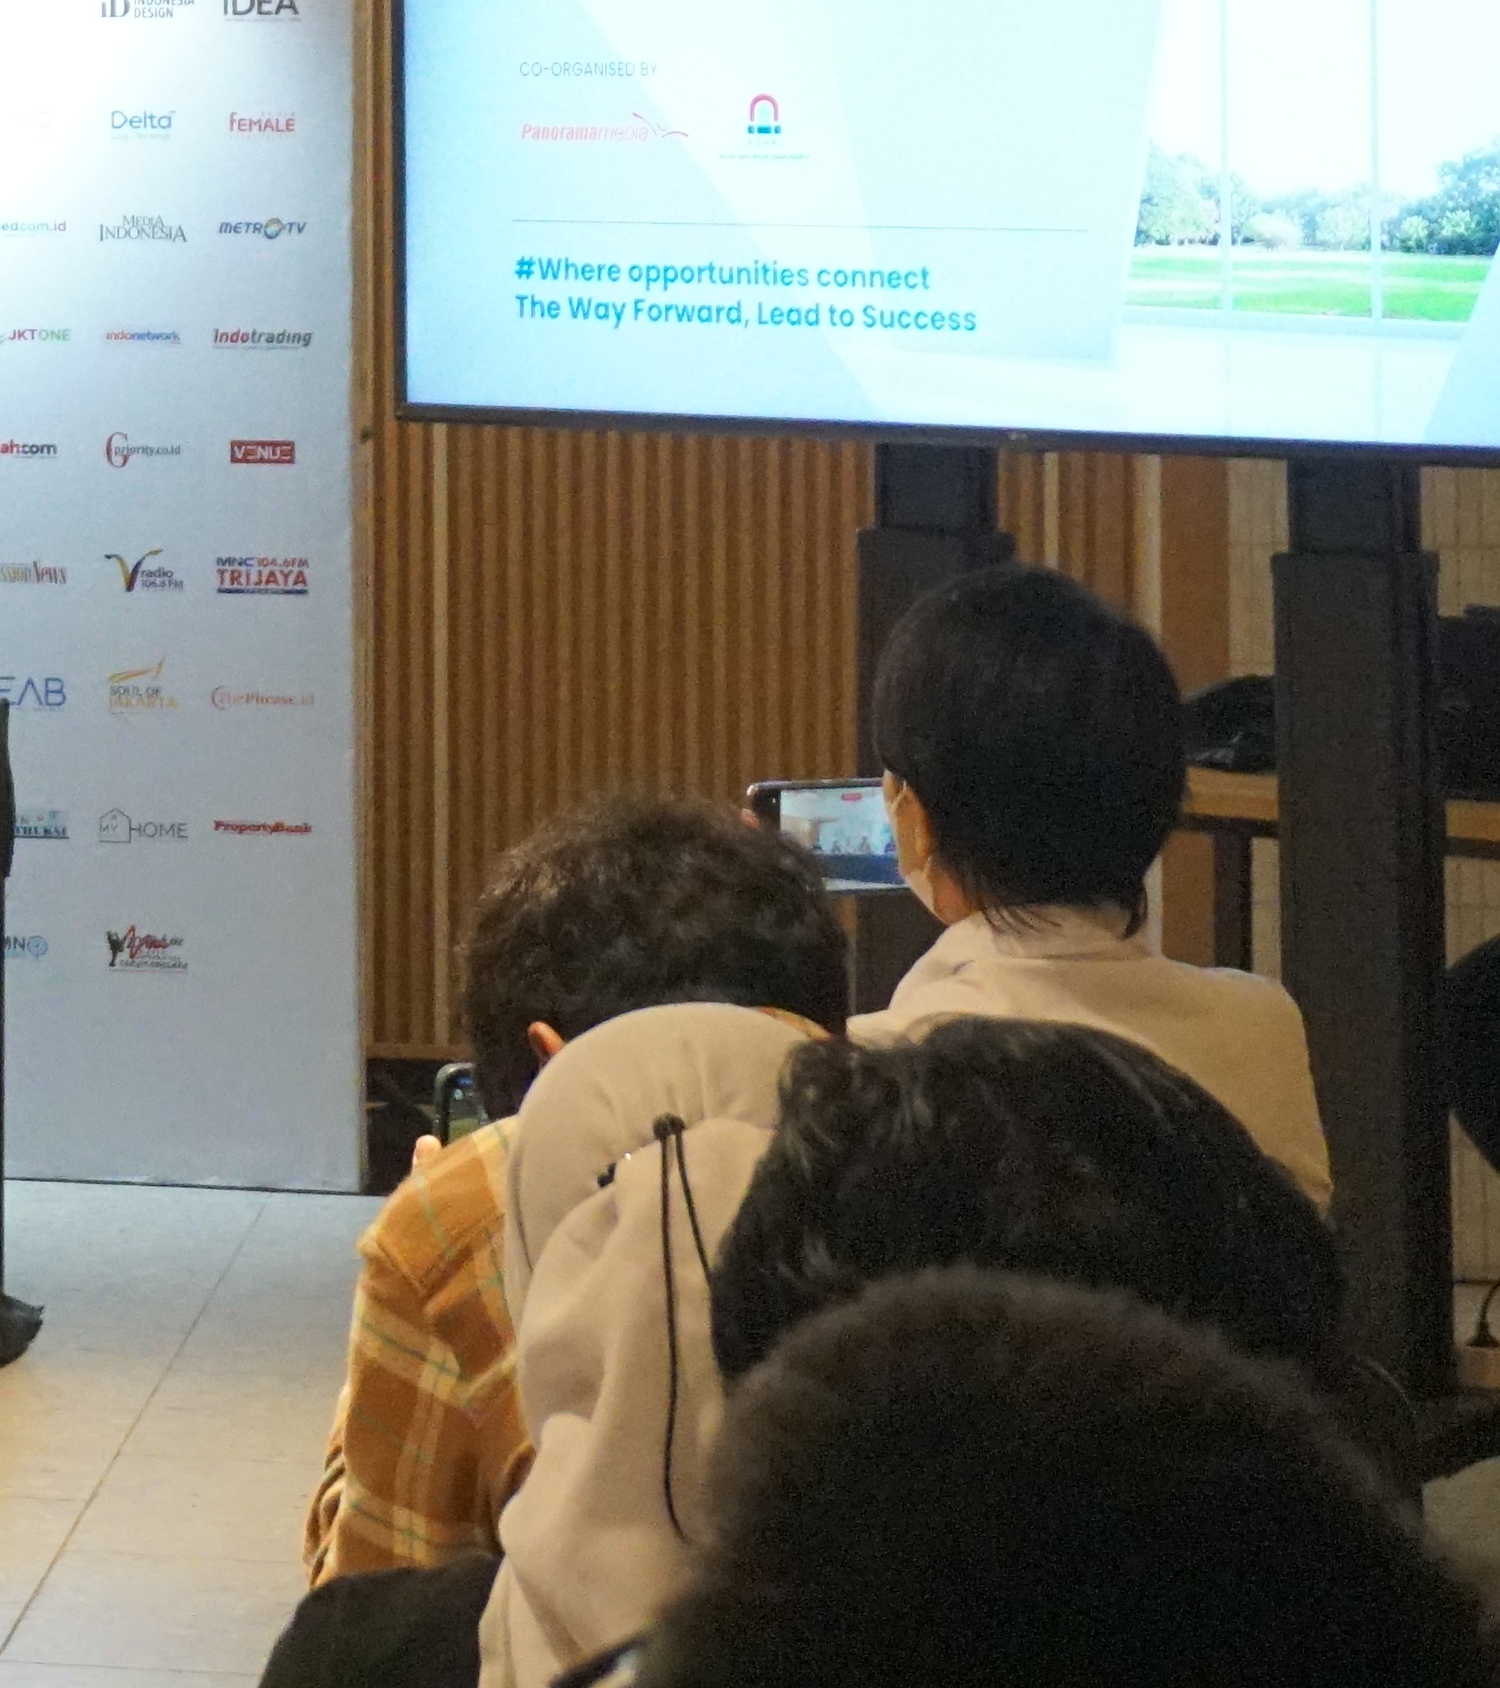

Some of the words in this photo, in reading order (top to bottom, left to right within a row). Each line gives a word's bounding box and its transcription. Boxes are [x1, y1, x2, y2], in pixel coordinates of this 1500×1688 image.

[133, 6, 175, 19] DESIGN
[519, 61, 636, 78] CO-ORGANISED
[639, 61, 658, 77] BY
[110, 109, 173, 131] Delta
[513, 254, 622, 283] #Where
[627, 258, 810, 292] opportunities
[816, 265, 931, 291] connect
[513, 293, 562, 320] The
[567, 295, 628, 330] Way
[632, 297, 751, 330] Forward,
[756, 300, 821, 329] Lead
[828, 301, 856, 328] to
[861, 304, 979, 332] Success
[212, 327, 314, 347] Indotrading
[140, 565, 174, 579] radio
[216, 570, 309, 587] TRIJAYA
[130, 822, 189, 839] HOME
